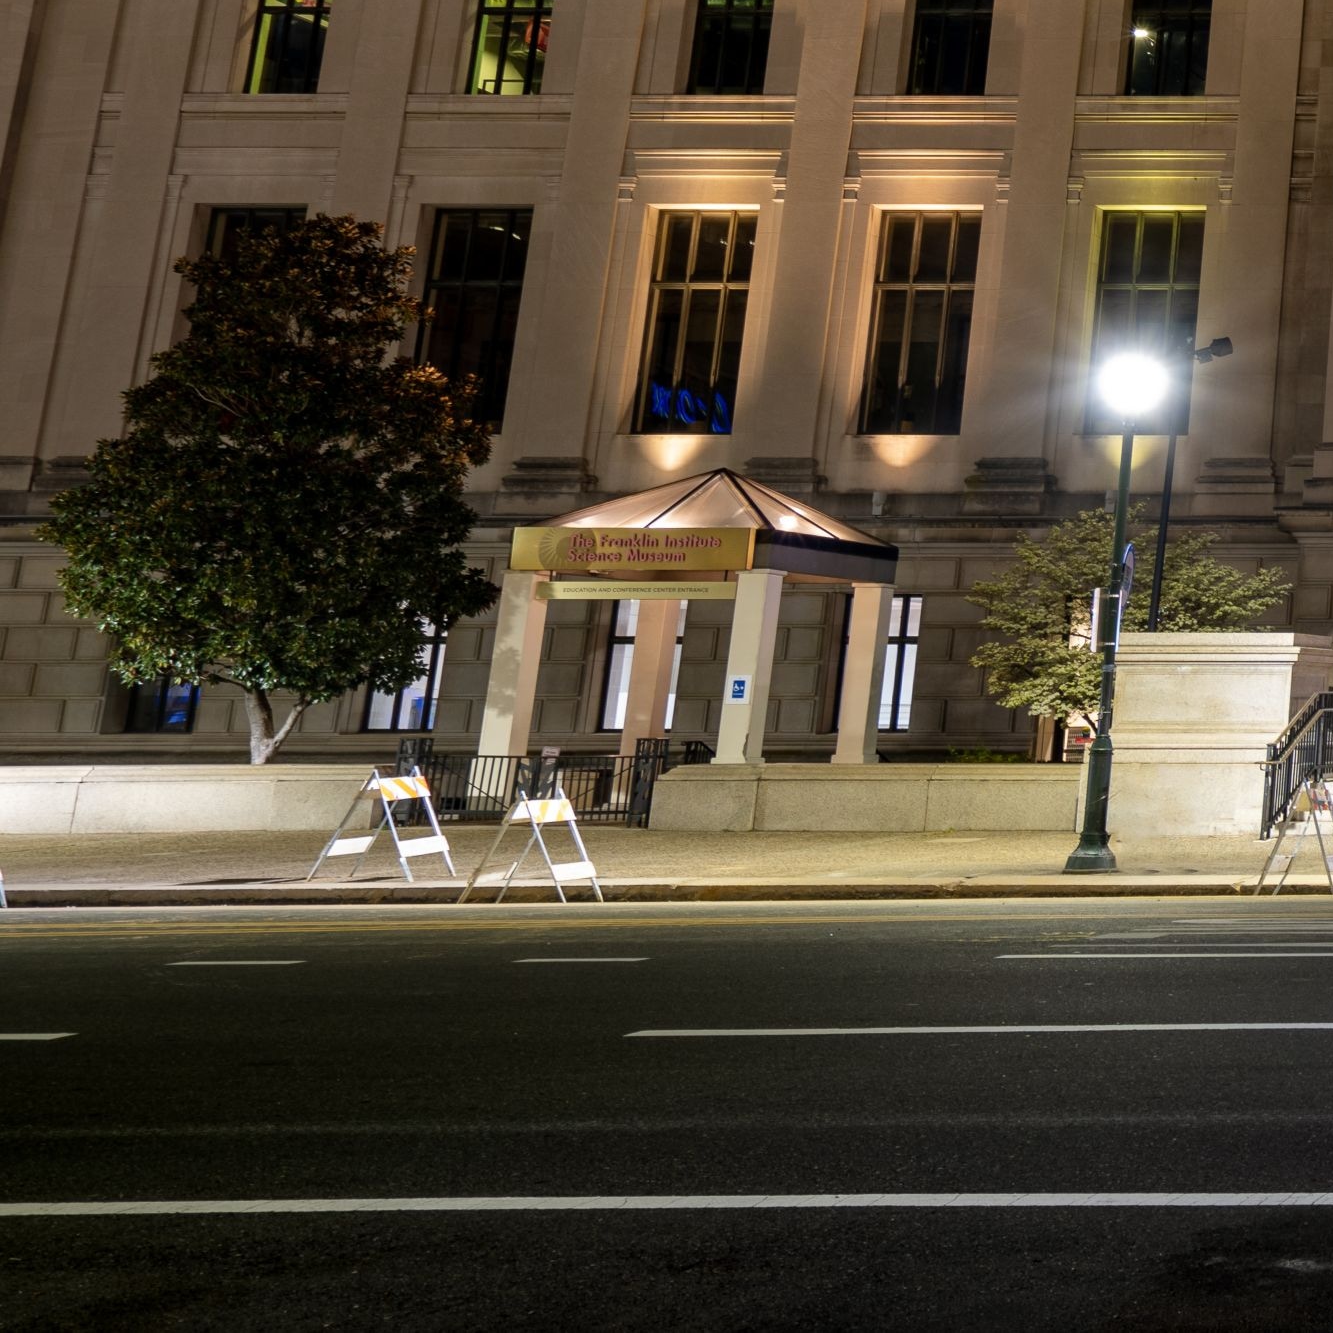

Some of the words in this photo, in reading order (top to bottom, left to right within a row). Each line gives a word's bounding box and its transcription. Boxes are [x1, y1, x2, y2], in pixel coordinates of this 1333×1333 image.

[570, 534, 595, 548] The
[600, 533, 659, 548] Franklin
[665, 533, 722, 548] Institute
[567, 548, 622, 562] Science
[627, 549, 686, 562] Museum
